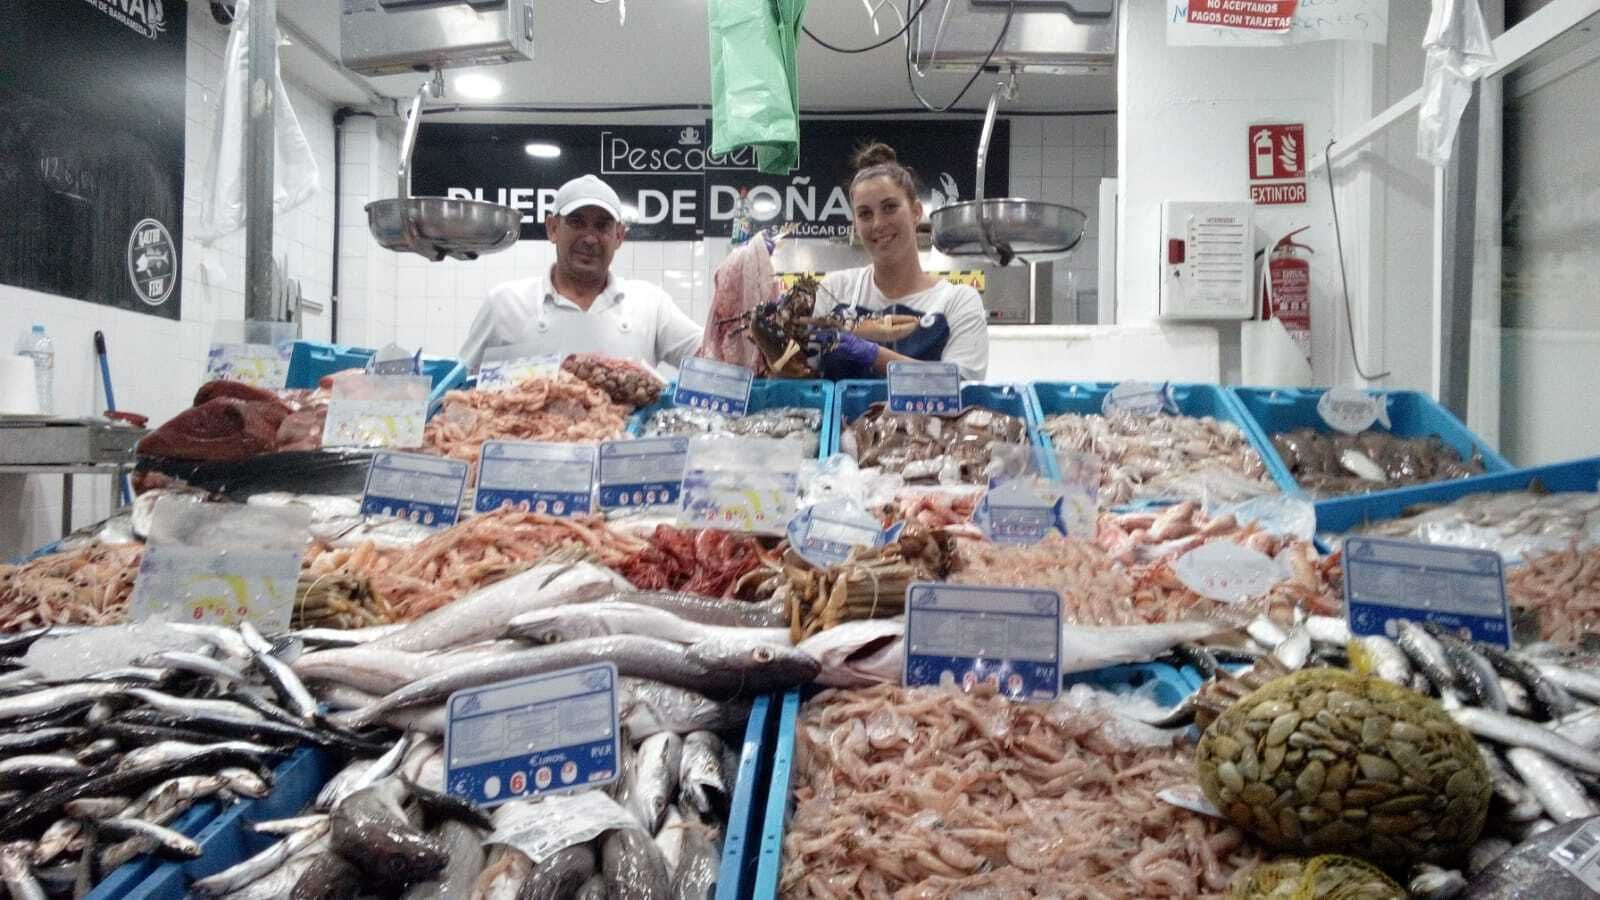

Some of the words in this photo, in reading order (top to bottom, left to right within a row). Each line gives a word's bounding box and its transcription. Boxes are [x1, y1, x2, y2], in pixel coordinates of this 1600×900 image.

[1207, 0, 1220, 9] NO
[1222, 0, 1278, 13] ACEPTAMOS
[1191, 11, 1221, 22] PAGOS
[1223, 14, 1242, 25] CON
[1244, 16, 1290, 27] TARJETAS
[638, 189, 697, 225] DE
[710, 176, 854, 221] DOÑA
[1251, 185, 1305, 202] EXTINTOR
